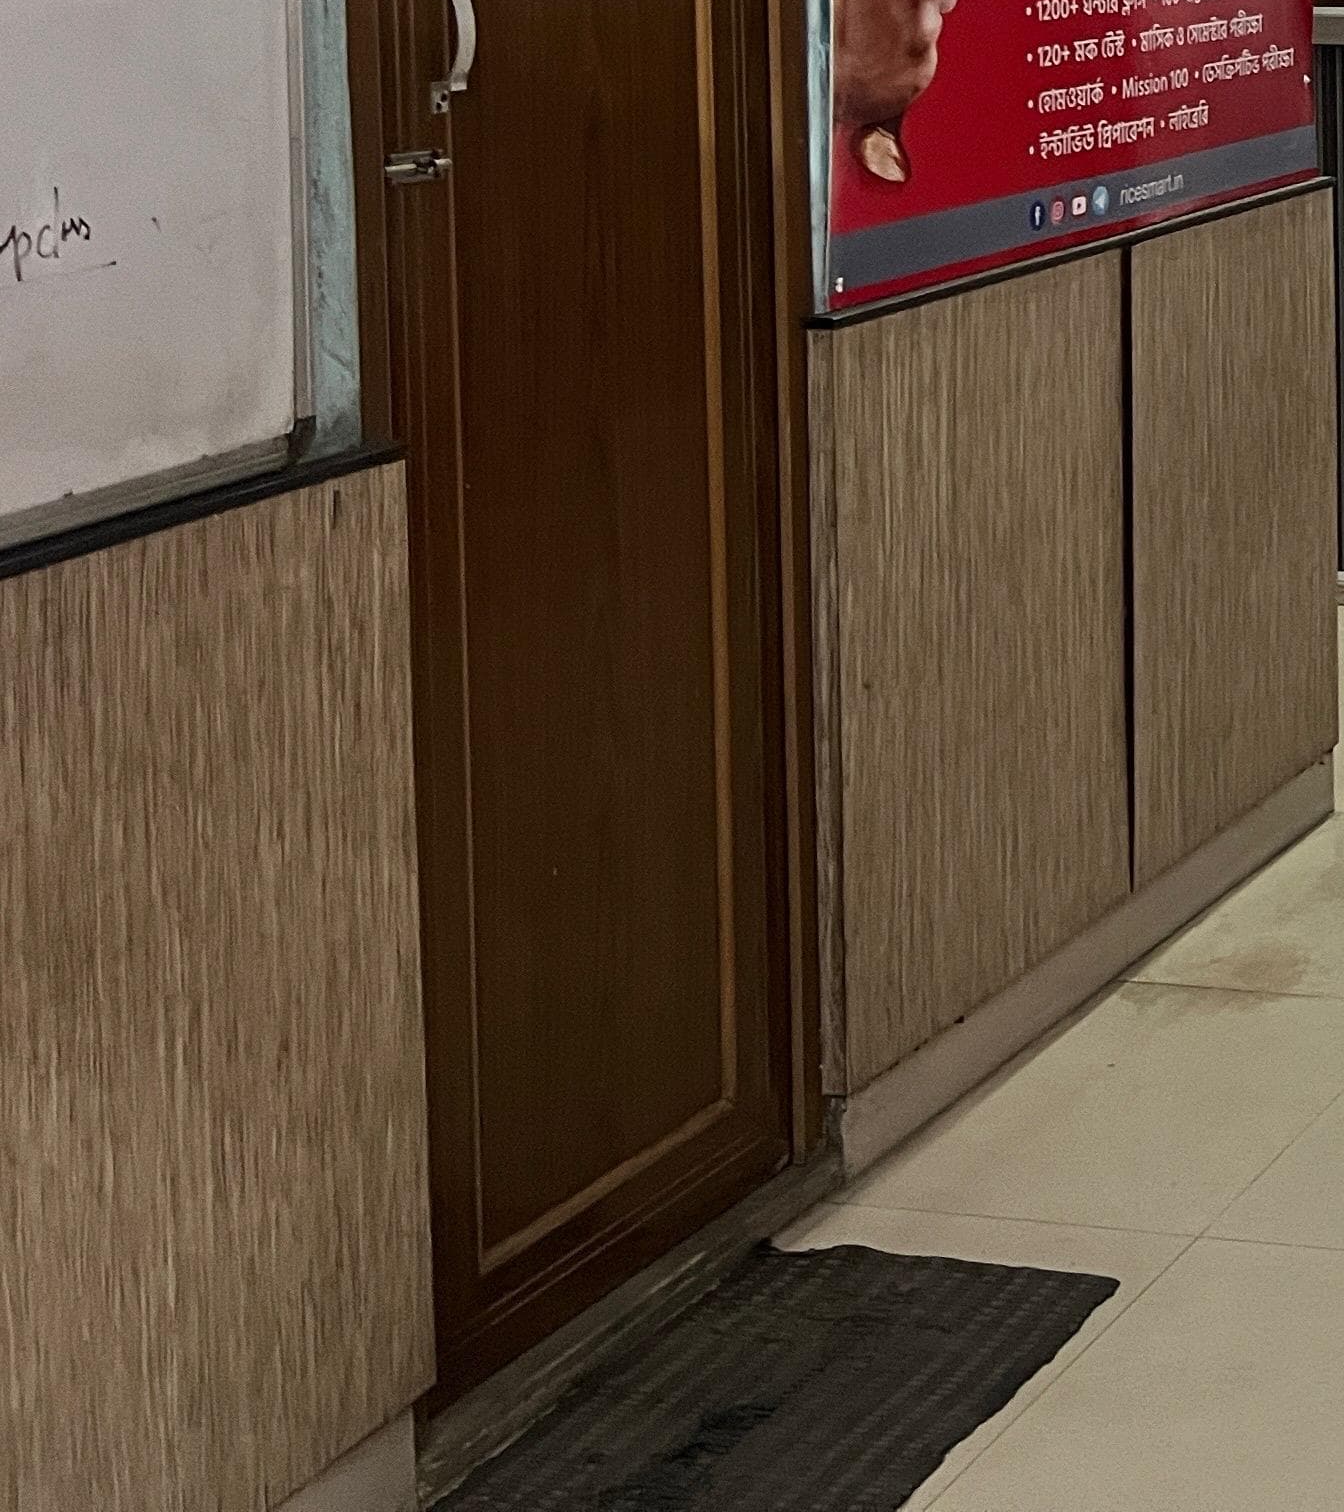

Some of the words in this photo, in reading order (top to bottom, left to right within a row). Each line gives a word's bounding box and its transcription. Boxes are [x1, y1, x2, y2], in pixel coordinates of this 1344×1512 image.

[1038, 44, 1070, 67] 120+
[1121, 75, 1168, 99] Mission
[1170, 68, 1189, 89] 100
[1120, 173, 1184, 206] ricesmart.in
